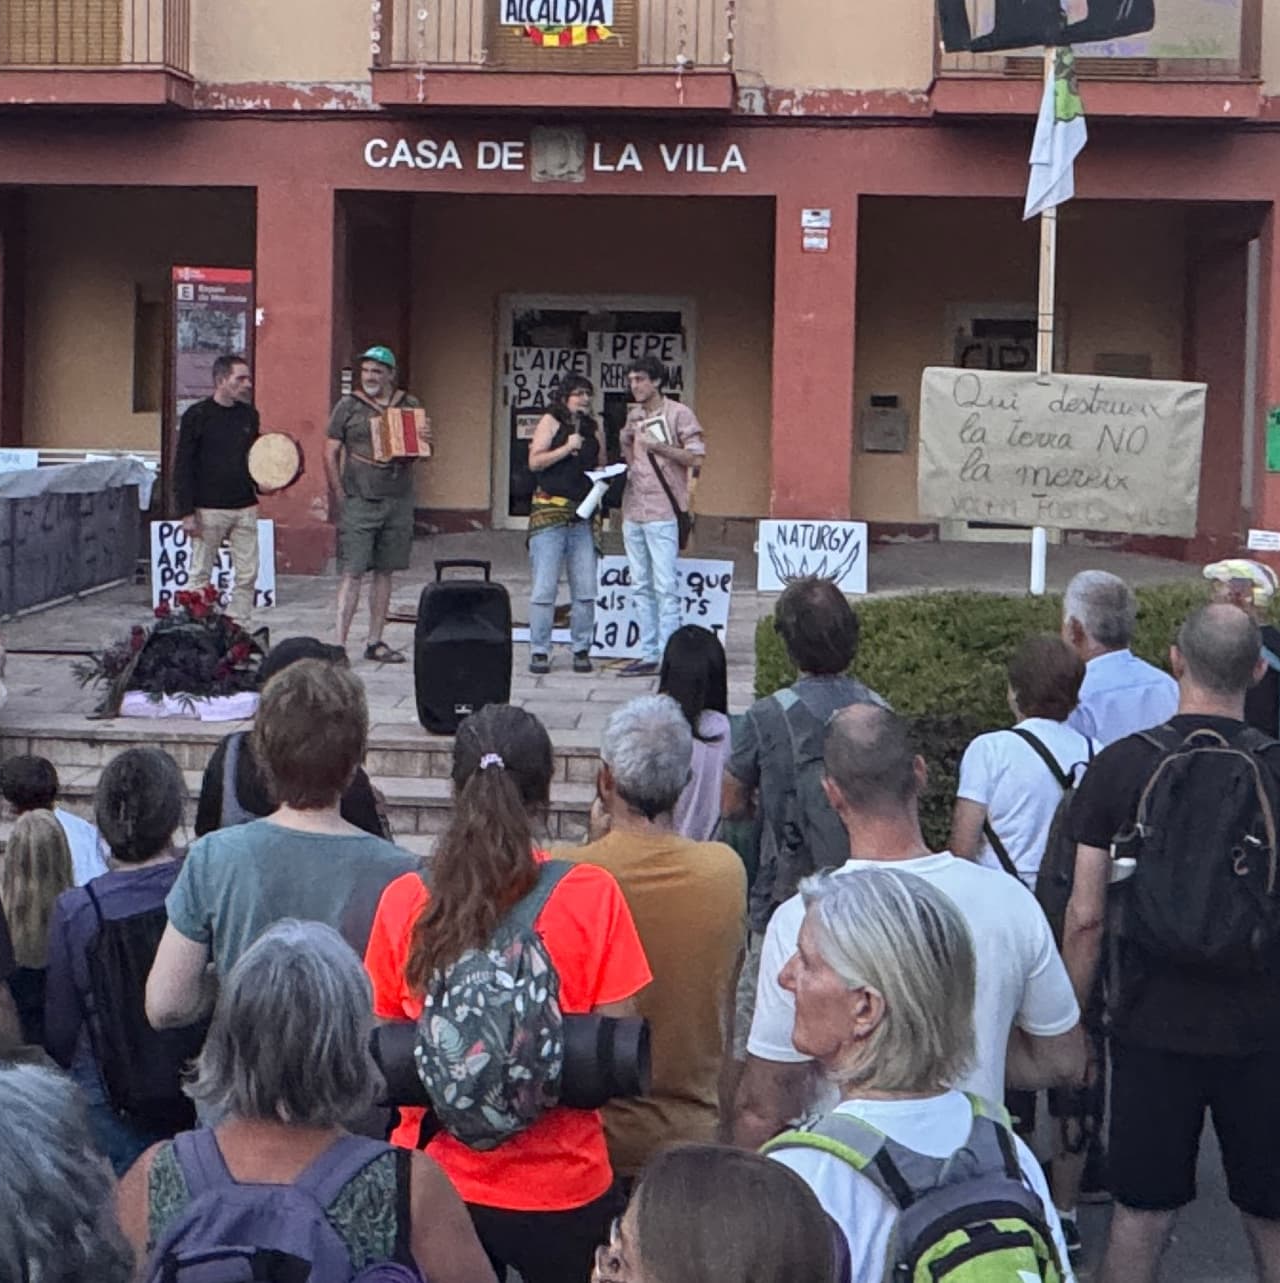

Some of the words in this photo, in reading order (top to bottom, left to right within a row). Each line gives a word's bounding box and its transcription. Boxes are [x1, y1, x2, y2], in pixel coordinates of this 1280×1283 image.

[365, 139, 462, 169] CASA
[477, 141, 525, 171] DE
[593, 143, 643, 172] LA
[660, 144, 747, 173] VILA
[612, 335, 677, 361] PEPE
[953, 373, 1018, 411] Qui
[959, 412, 987, 445] la
[1008, 419, 1072, 448] terra
[1097, 424, 1149, 455] NO
[959, 446, 990, 482] la
[1017, 464, 1129, 490] mereix
[777, 523, 854, 553] NATURGY
[597, 590, 626, 610] els
[687, 571, 731, 597] que
